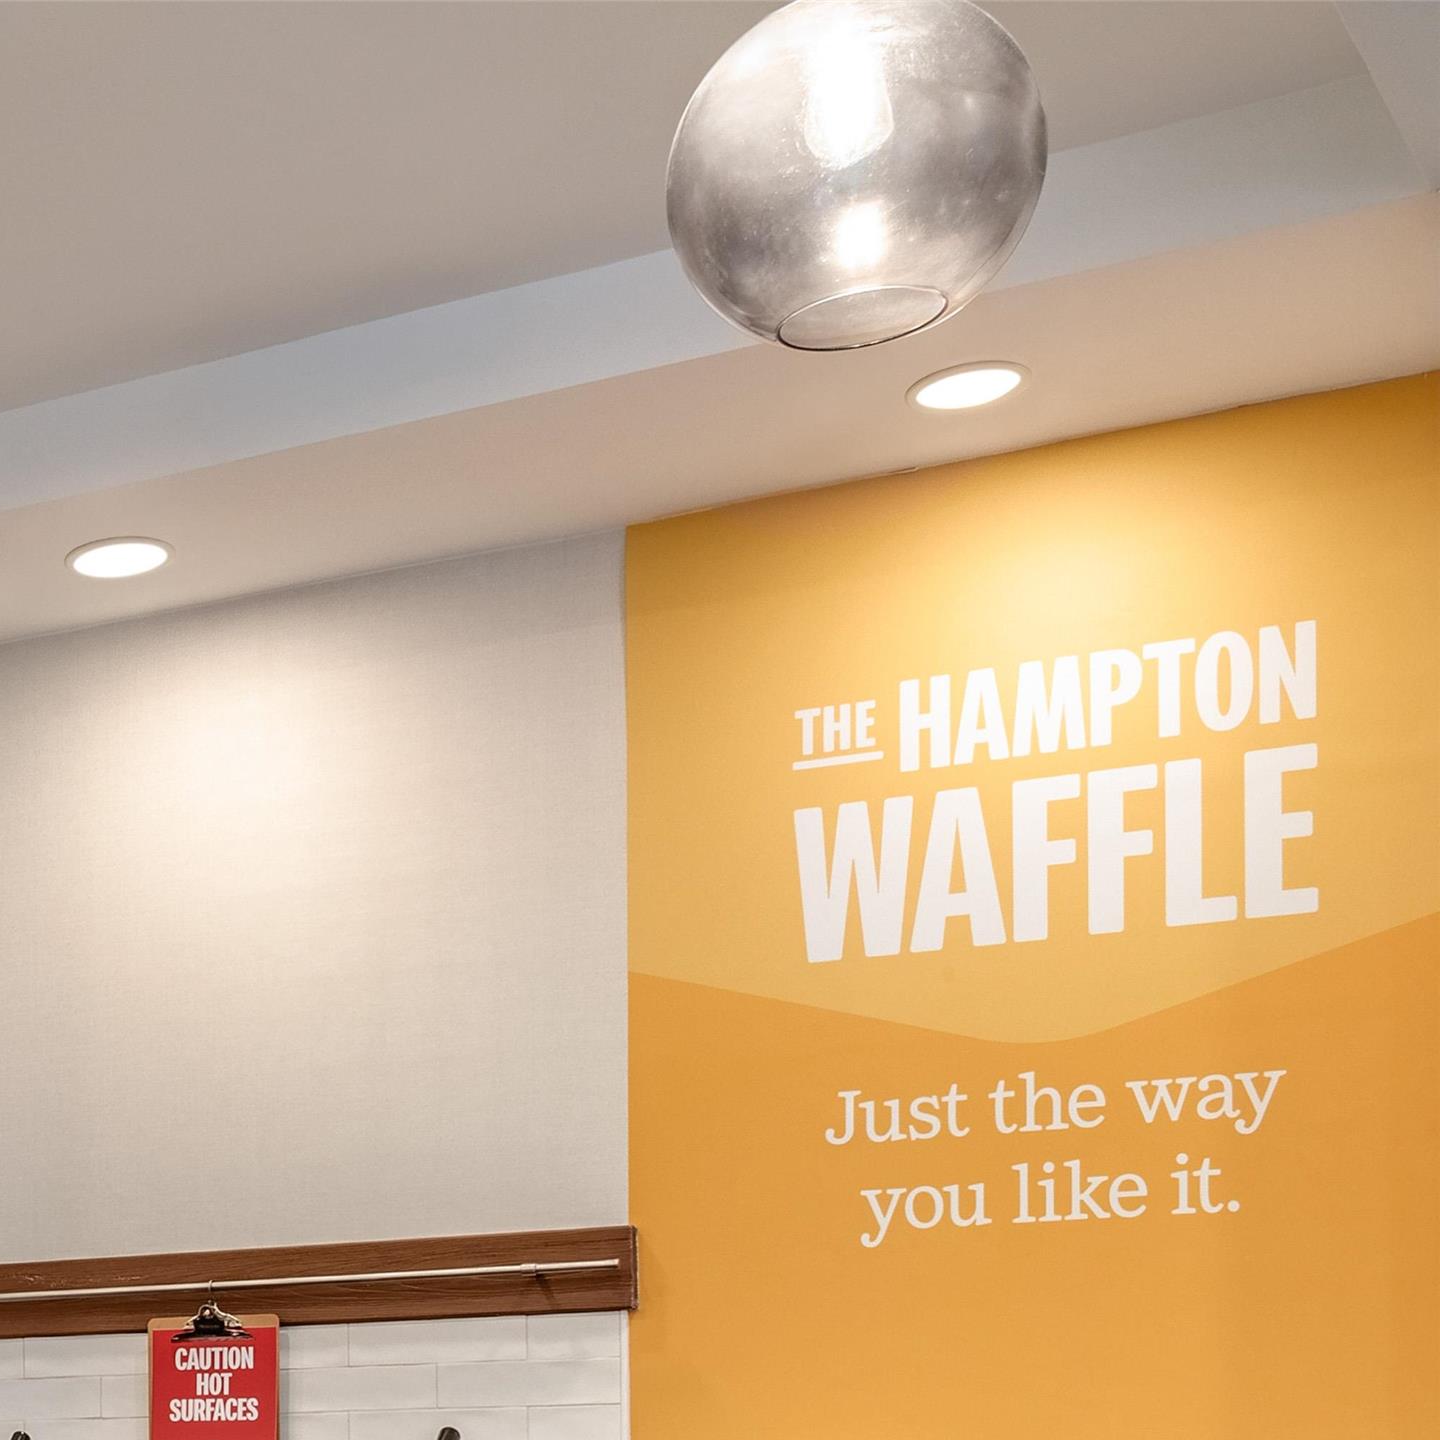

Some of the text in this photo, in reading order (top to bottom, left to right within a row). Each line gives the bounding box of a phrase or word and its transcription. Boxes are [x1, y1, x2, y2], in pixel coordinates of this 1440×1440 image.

[794, 619, 1317, 773] THE HAMPTON
[793, 742, 1318, 964] WAFFLE
[825, 1068, 1287, 1145] Just the way
[860, 1153, 1241, 1248] you like it.
[174, 1346, 255, 1371] CAUTION
[195, 1372, 233, 1396] HOT
[169, 1397, 259, 1422] SURFACES
